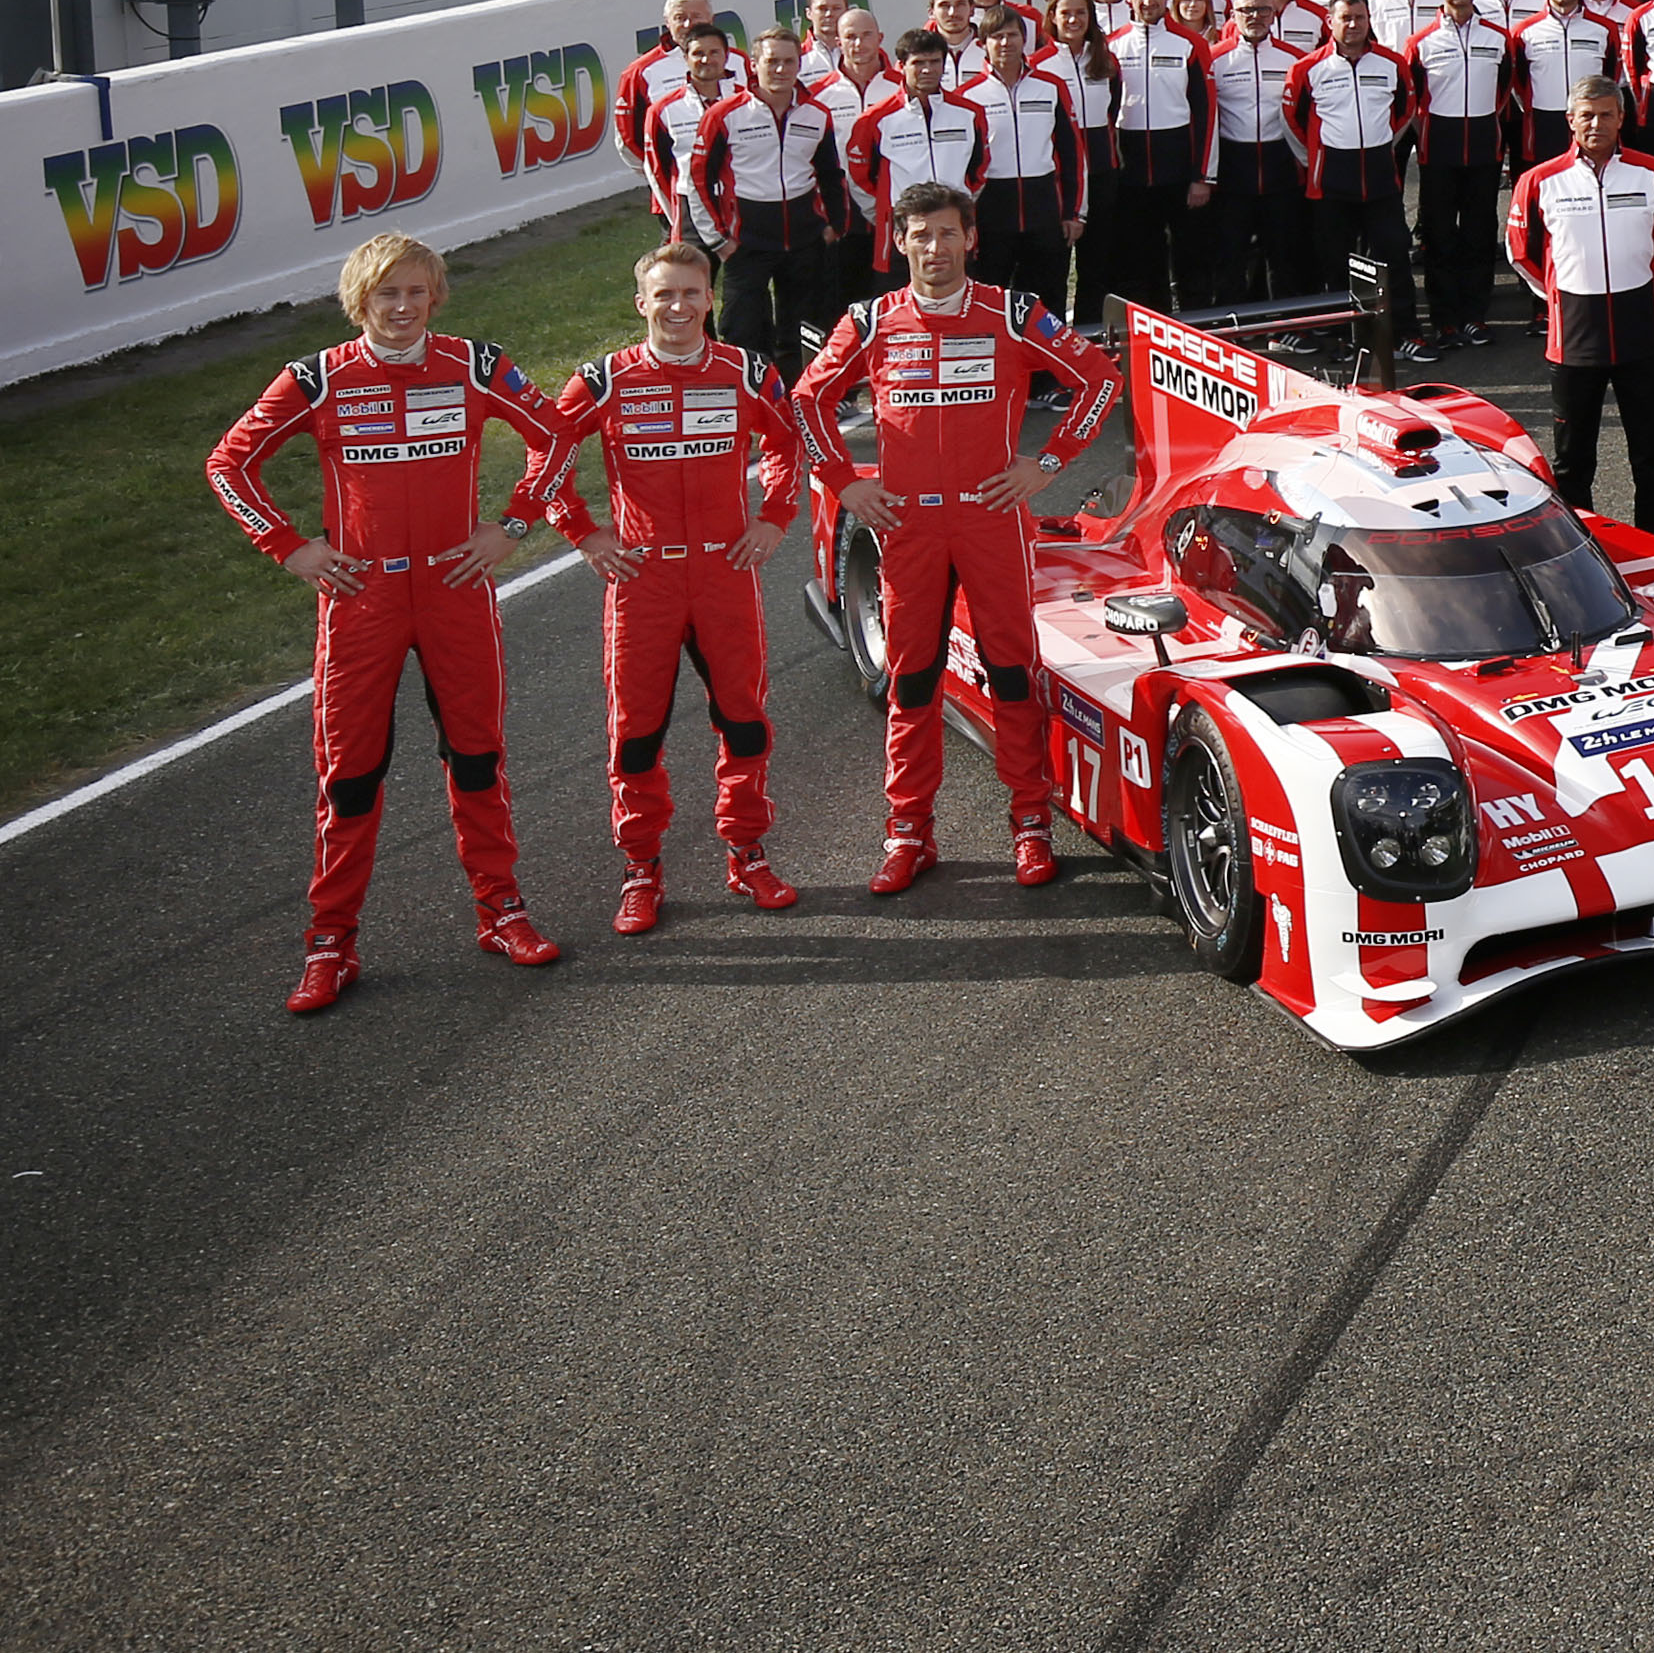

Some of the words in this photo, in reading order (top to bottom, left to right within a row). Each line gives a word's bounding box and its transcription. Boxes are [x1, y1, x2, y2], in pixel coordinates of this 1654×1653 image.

[473, 42, 610, 179] VSD
[280, 79, 442, 228] VSD
[44, 123, 241, 292] VSD
[890, 350, 918, 359] Mobil
[1133, 311, 1257, 387] PORSCHE
[954, 363, 991, 373] WEC
[893, 392, 934, 403] DMG
[941, 389, 993, 402] MORI
[1091, 381, 1113, 419] MORI
[1151, 354, 1197, 400] DMG
[1203, 381, 1255, 426] MORI
[339, 402, 378, 414] Mobil
[622, 402, 658, 413] Mobil
[698, 414, 734, 423] WEC
[422, 413, 462, 425] WEC
[345, 448, 399, 460] DMG
[408, 440, 463, 457] MORI
[628, 446, 677, 457] DMG
[684, 440, 732, 455] MORI
[236, 500, 270, 533] MORI
[1366, 503, 1566, 545] PORSCHE
[703, 542, 726, 552] Timo
[1104, 605, 1158, 632] CHOPARD
[1504, 691, 1596, 722] DMG
[1621, 730, 1643, 740] LE
[1124, 736, 1144, 779] P1
[1067, 737, 1100, 824] 17
[1479, 793, 1546, 829] HY
[1251, 817, 1299, 844] SCHAEFFLER
[1502, 828, 1552, 849] Mobil
[1277, 850, 1298, 867] FAG
[1532, 840, 1577, 855] MICHELIN
[1519, 849, 1585, 872] CHOPARD
[1342, 932, 1386, 944] DMG
[1390, 929, 1444, 944] MORI
